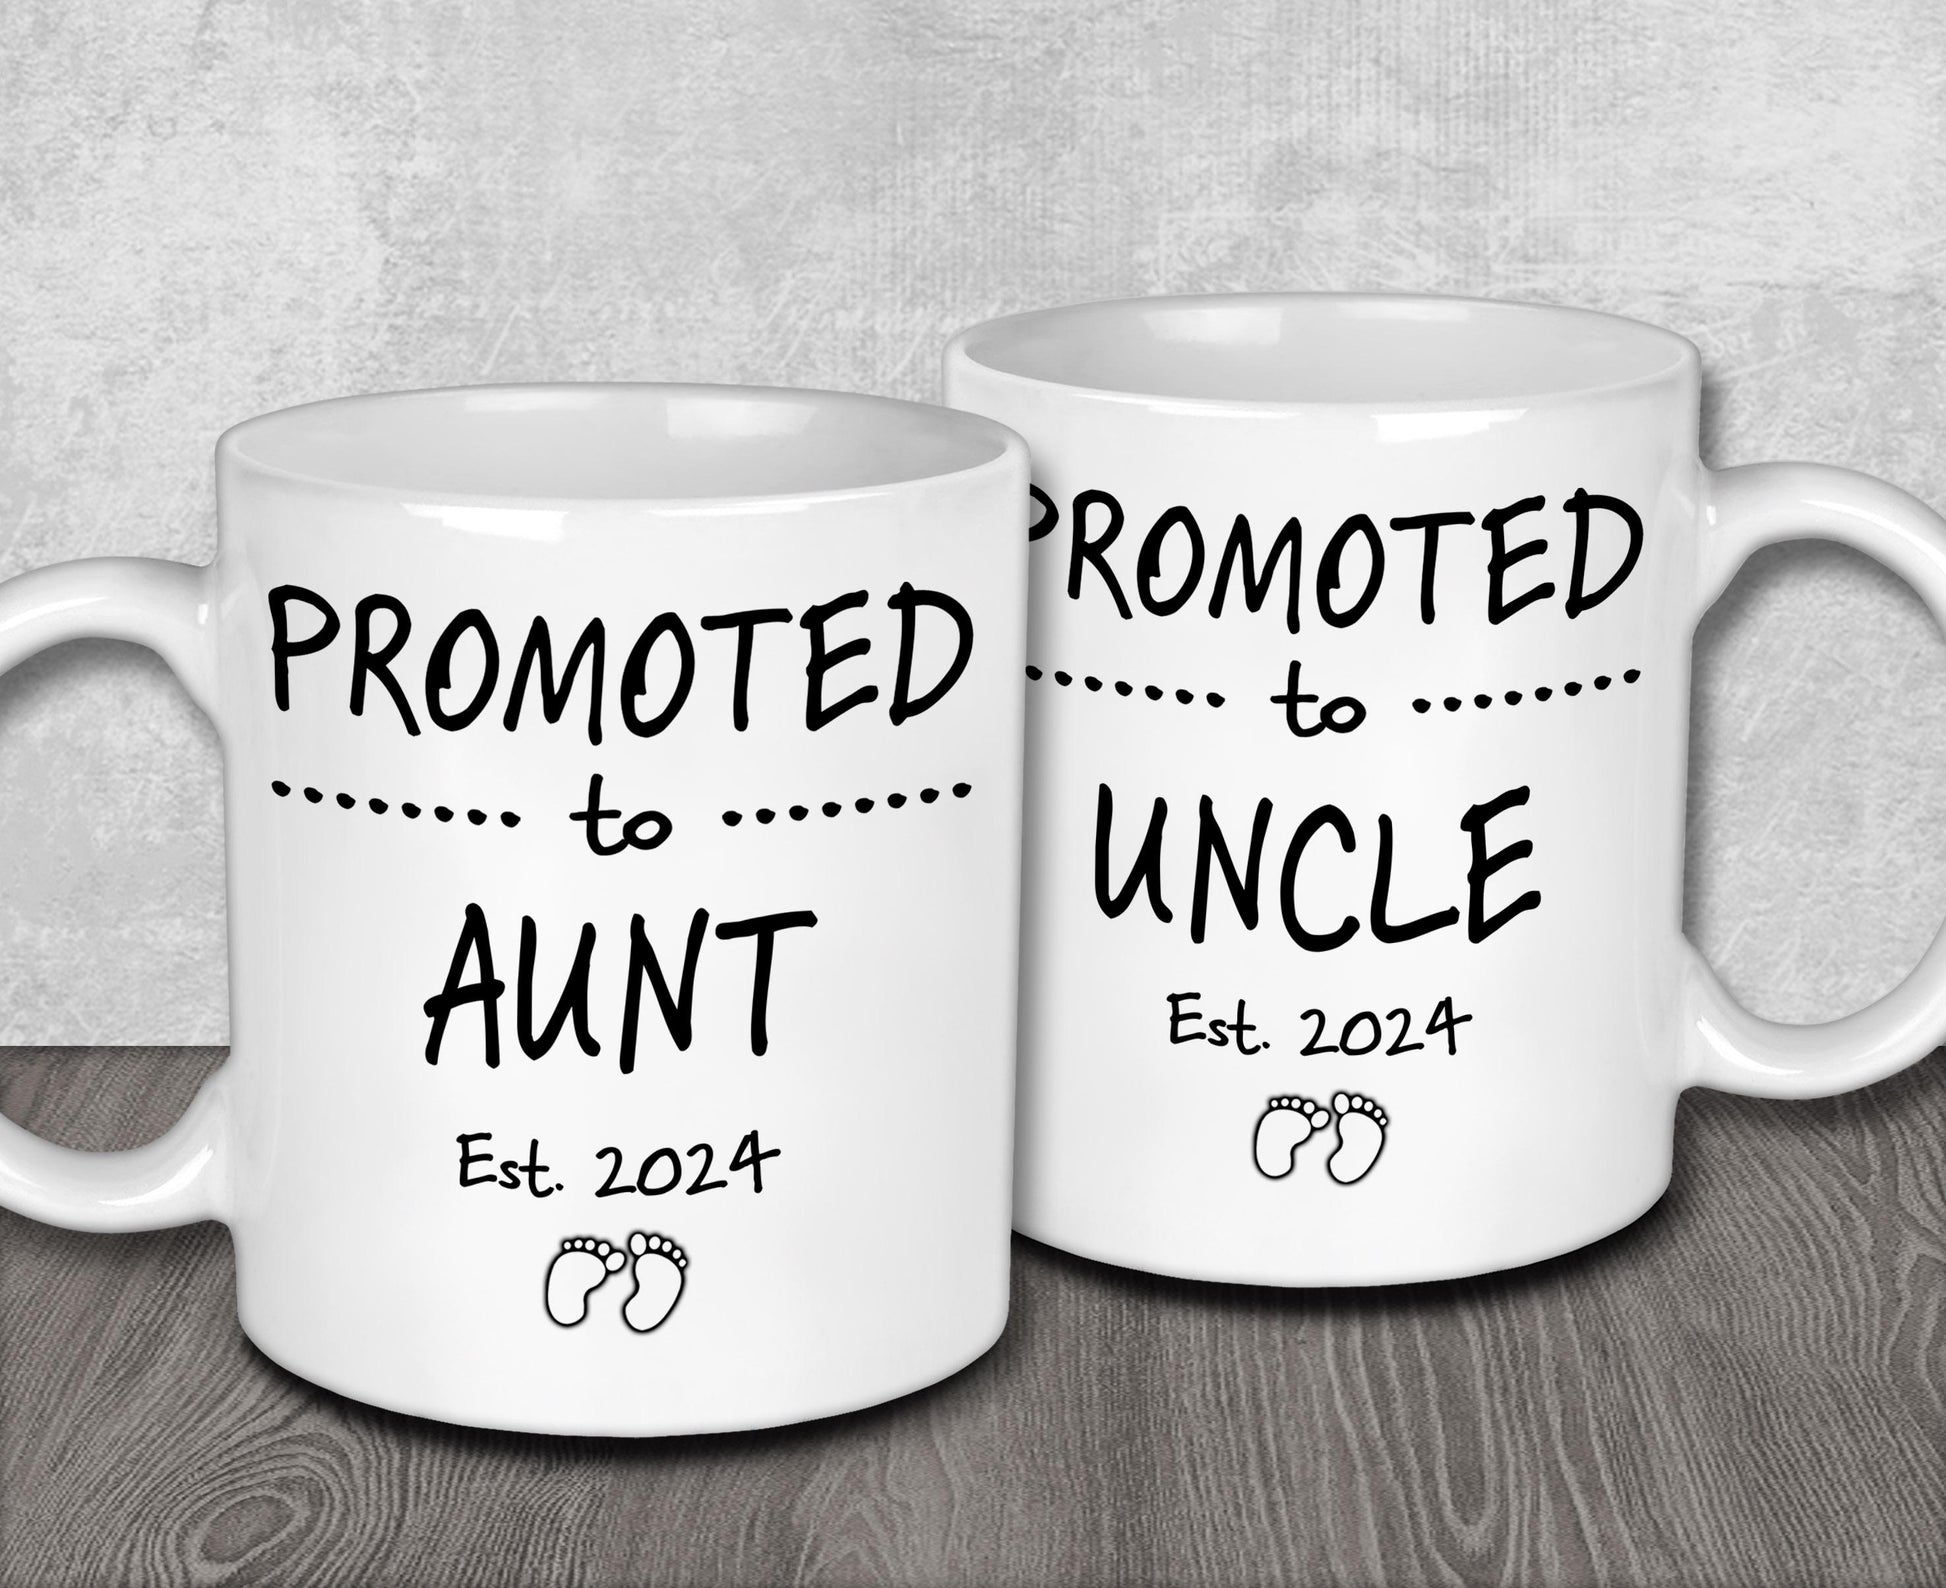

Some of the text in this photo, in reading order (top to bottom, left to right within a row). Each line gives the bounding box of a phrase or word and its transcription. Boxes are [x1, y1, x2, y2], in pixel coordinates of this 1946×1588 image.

[268, 585, 973, 746] PROMOTED
[1270, 660, 1366, 737] to
[569, 774, 672, 855] to
[1095, 783, 1541, 952] UNCLE
[424, 903, 817, 1074] AUNT
[1167, 992, 1472, 1056] Est. 2024
[457, 1130, 781, 1197] Est. 2024
